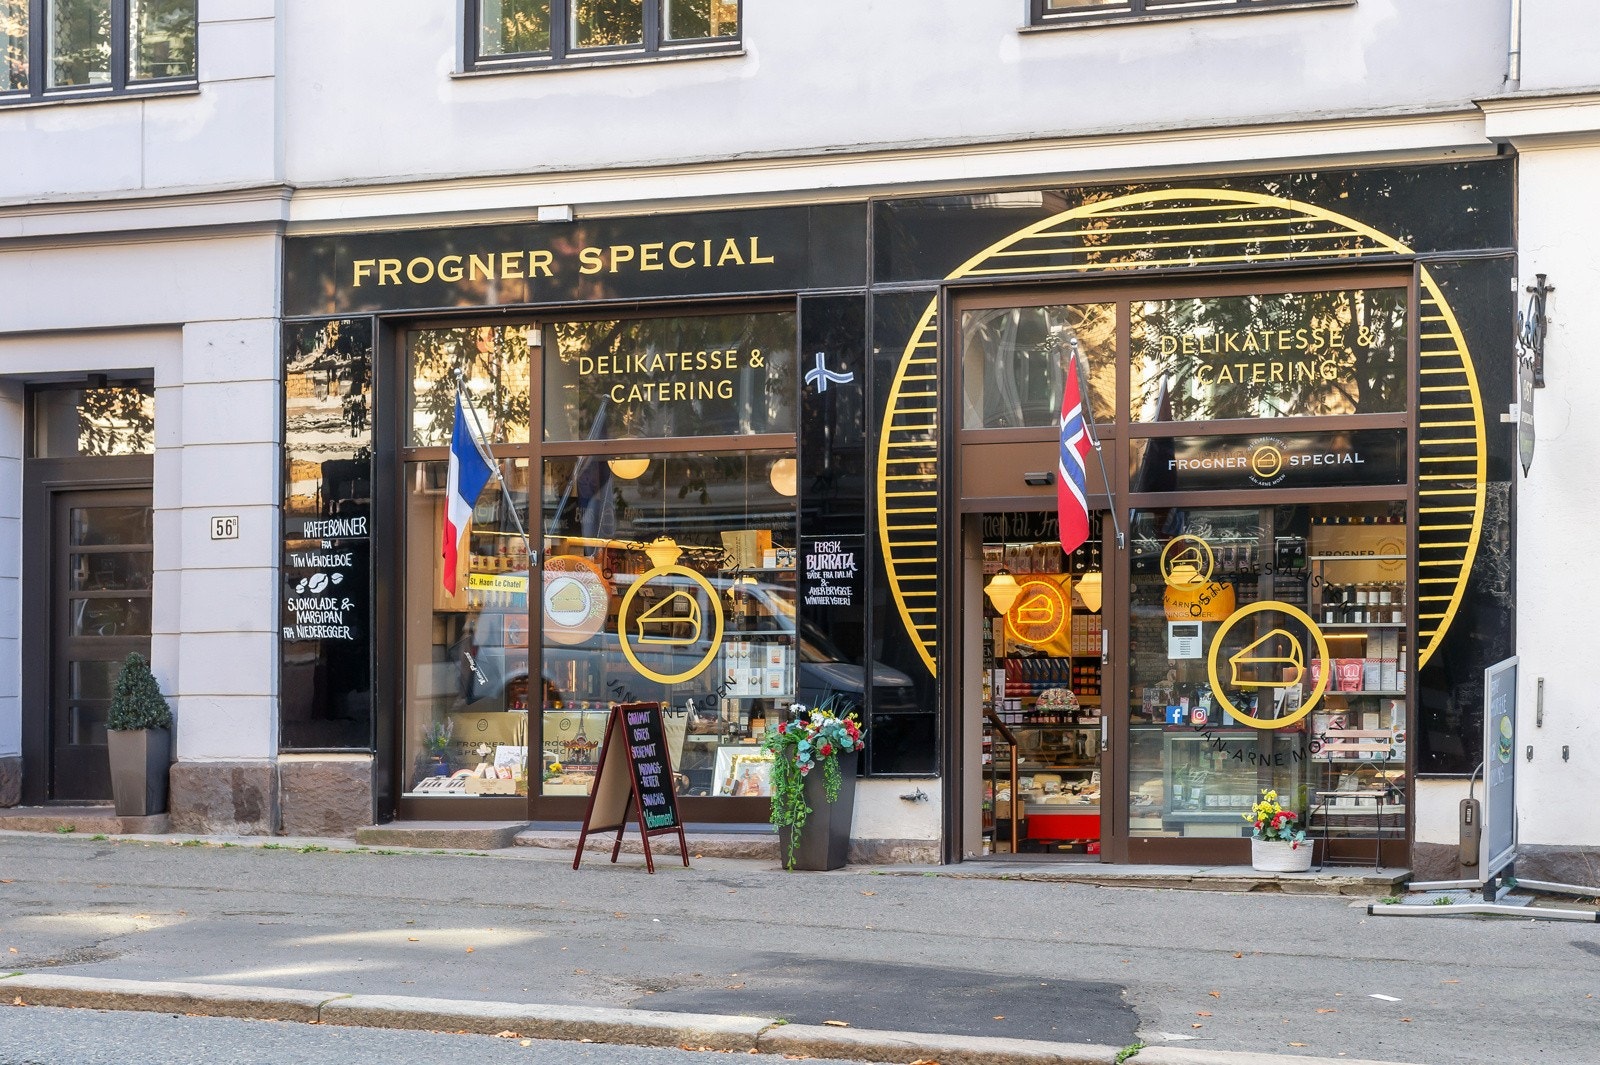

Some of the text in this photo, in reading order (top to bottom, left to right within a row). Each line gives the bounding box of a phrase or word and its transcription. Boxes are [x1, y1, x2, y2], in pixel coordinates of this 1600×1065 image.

[353, 237, 775, 287] FROGNER SPECIAL
[1161, 326, 1375, 355] DELIKATESSE &
[579, 349, 765, 376] DELIKATESSE &
[1198, 360, 1338, 386] CATERING
[610, 380, 734, 403] CATERING
[1168, 452, 1365, 471] FROGNER SPECIAL
[303, 516, 368, 538] KAFFEBØNNER
[321, 540, 333, 549] FRA
[814, 542, 841, 552] FERSK
[305, 552, 353, 568] WENDELBOE
[806, 552, 858, 571] BURRATA
[469, 577, 479, 585] St.
[826, 586, 853, 595] BRYGGE
[287, 597, 355, 611] SJOKOLADE &
[296, 610, 343, 625] MARSIPAN
[283, 624, 354, 640] FRA NIEDEREGGER
